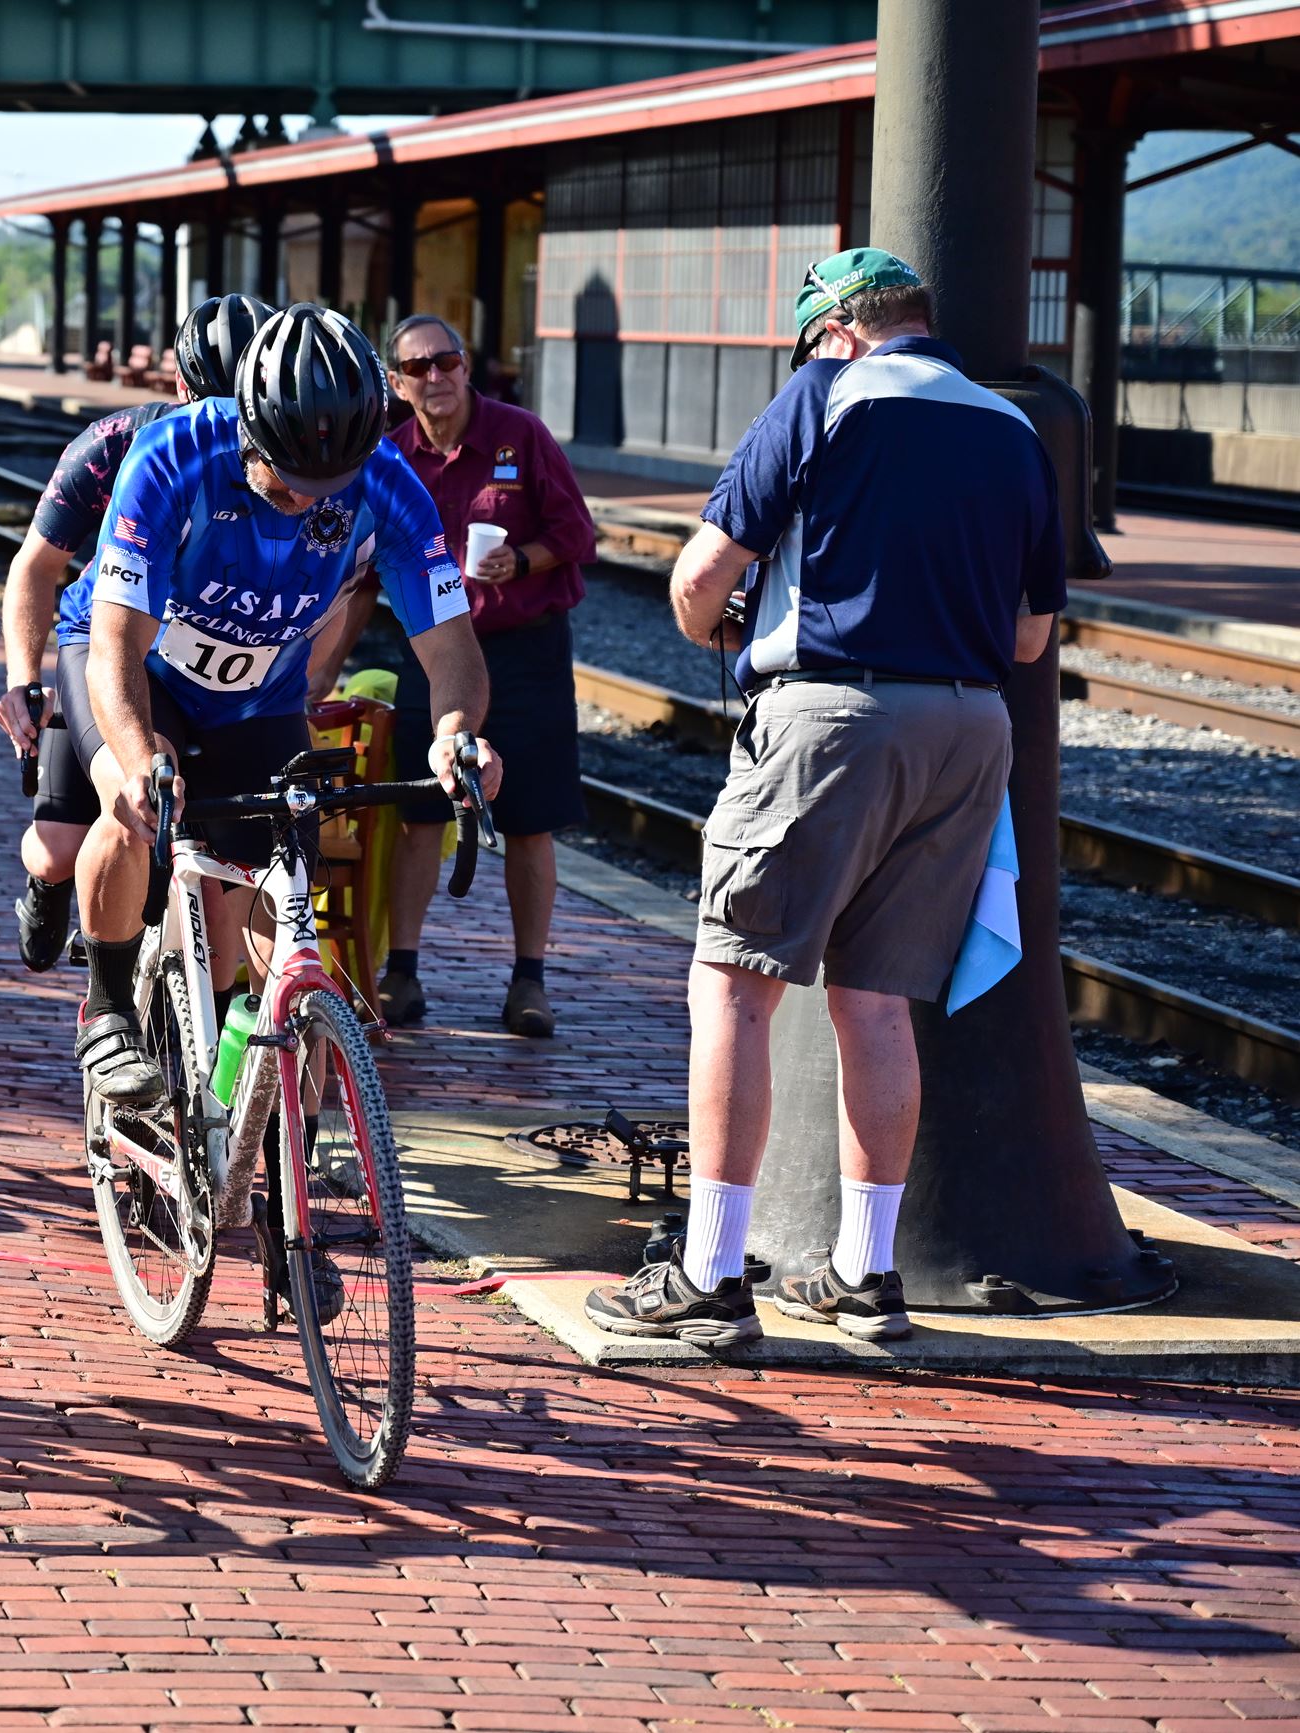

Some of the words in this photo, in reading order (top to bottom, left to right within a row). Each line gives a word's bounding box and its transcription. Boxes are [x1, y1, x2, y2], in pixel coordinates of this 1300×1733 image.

[811, 267, 865, 305] euopcar
[100, 562, 144, 586] AFCT
[437, 575, 462, 597] AFC
[165, 598, 266, 645] CYCLING
[199, 580, 320, 622] USAF
[185, 642, 255, 685] 10
[186, 891, 208, 974] RIDLEY
